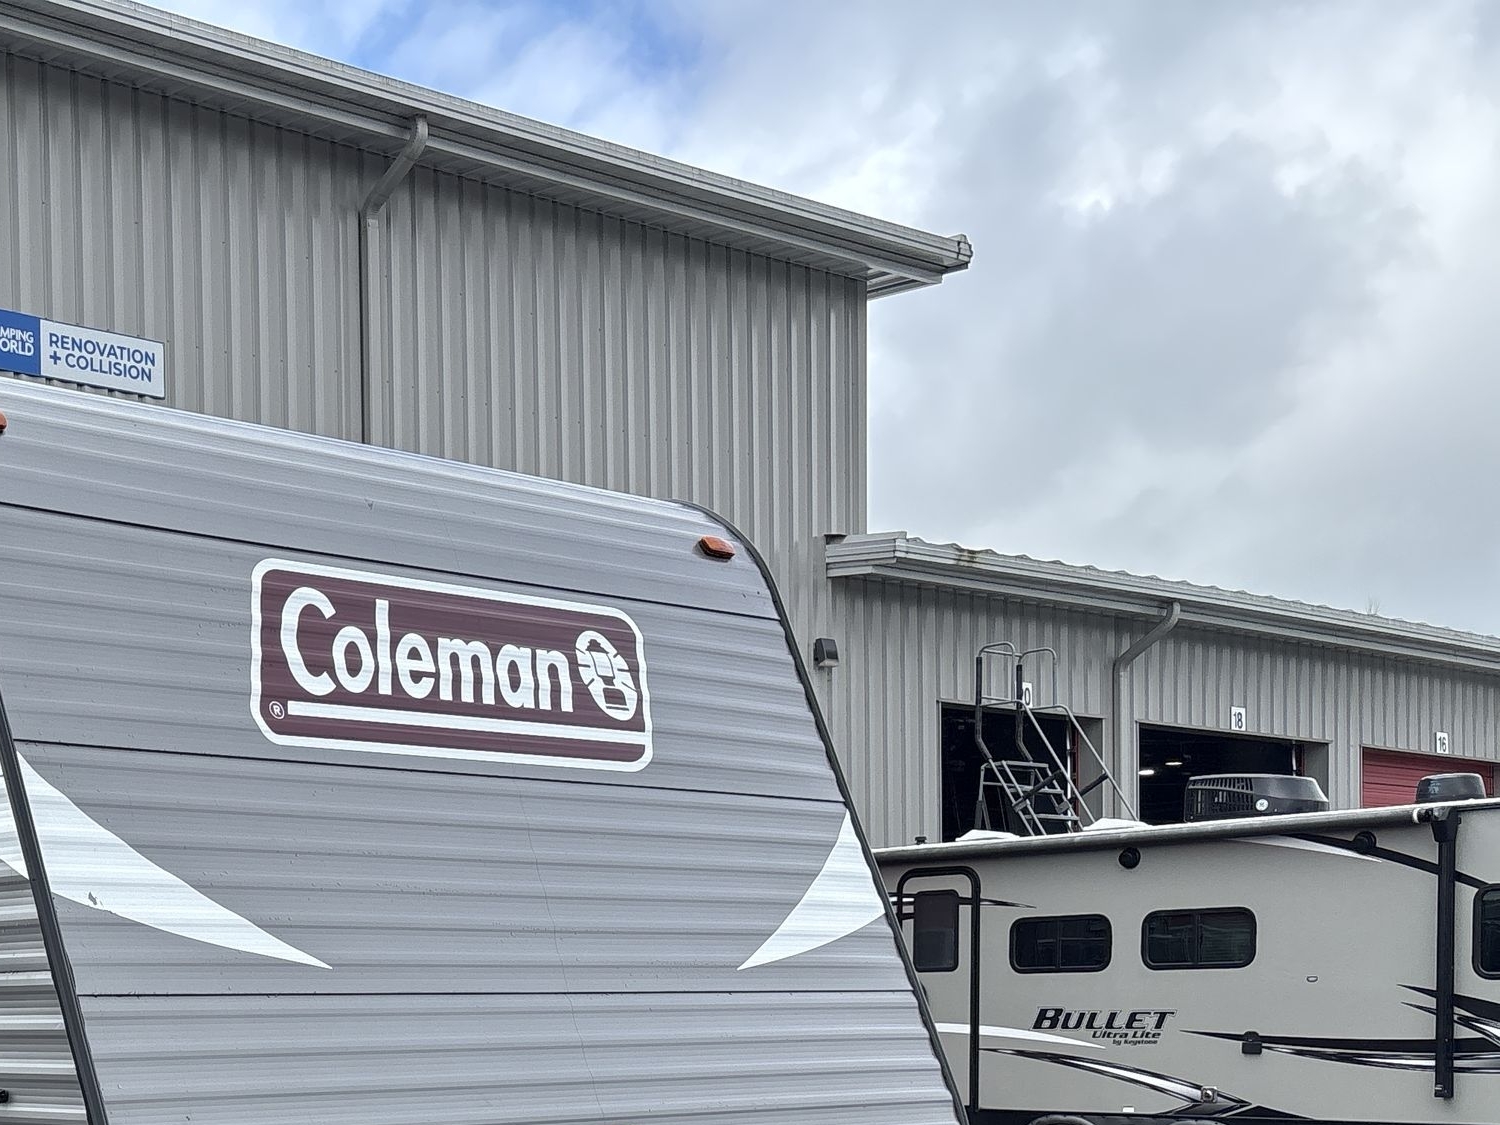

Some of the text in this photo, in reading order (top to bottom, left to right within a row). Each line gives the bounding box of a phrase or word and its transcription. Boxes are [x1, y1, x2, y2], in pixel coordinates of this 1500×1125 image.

[49, 333, 156, 367] RENOVATION
[65, 353, 152, 382] COLLISION
[280, 586, 574, 713] Coleman
[1233, 711, 1244, 729] 18
[1438, 736, 1447, 752] 16
[1032, 1007, 1176, 1030] BULLET
[1092, 1031, 1161, 1039] Ultra Lite
